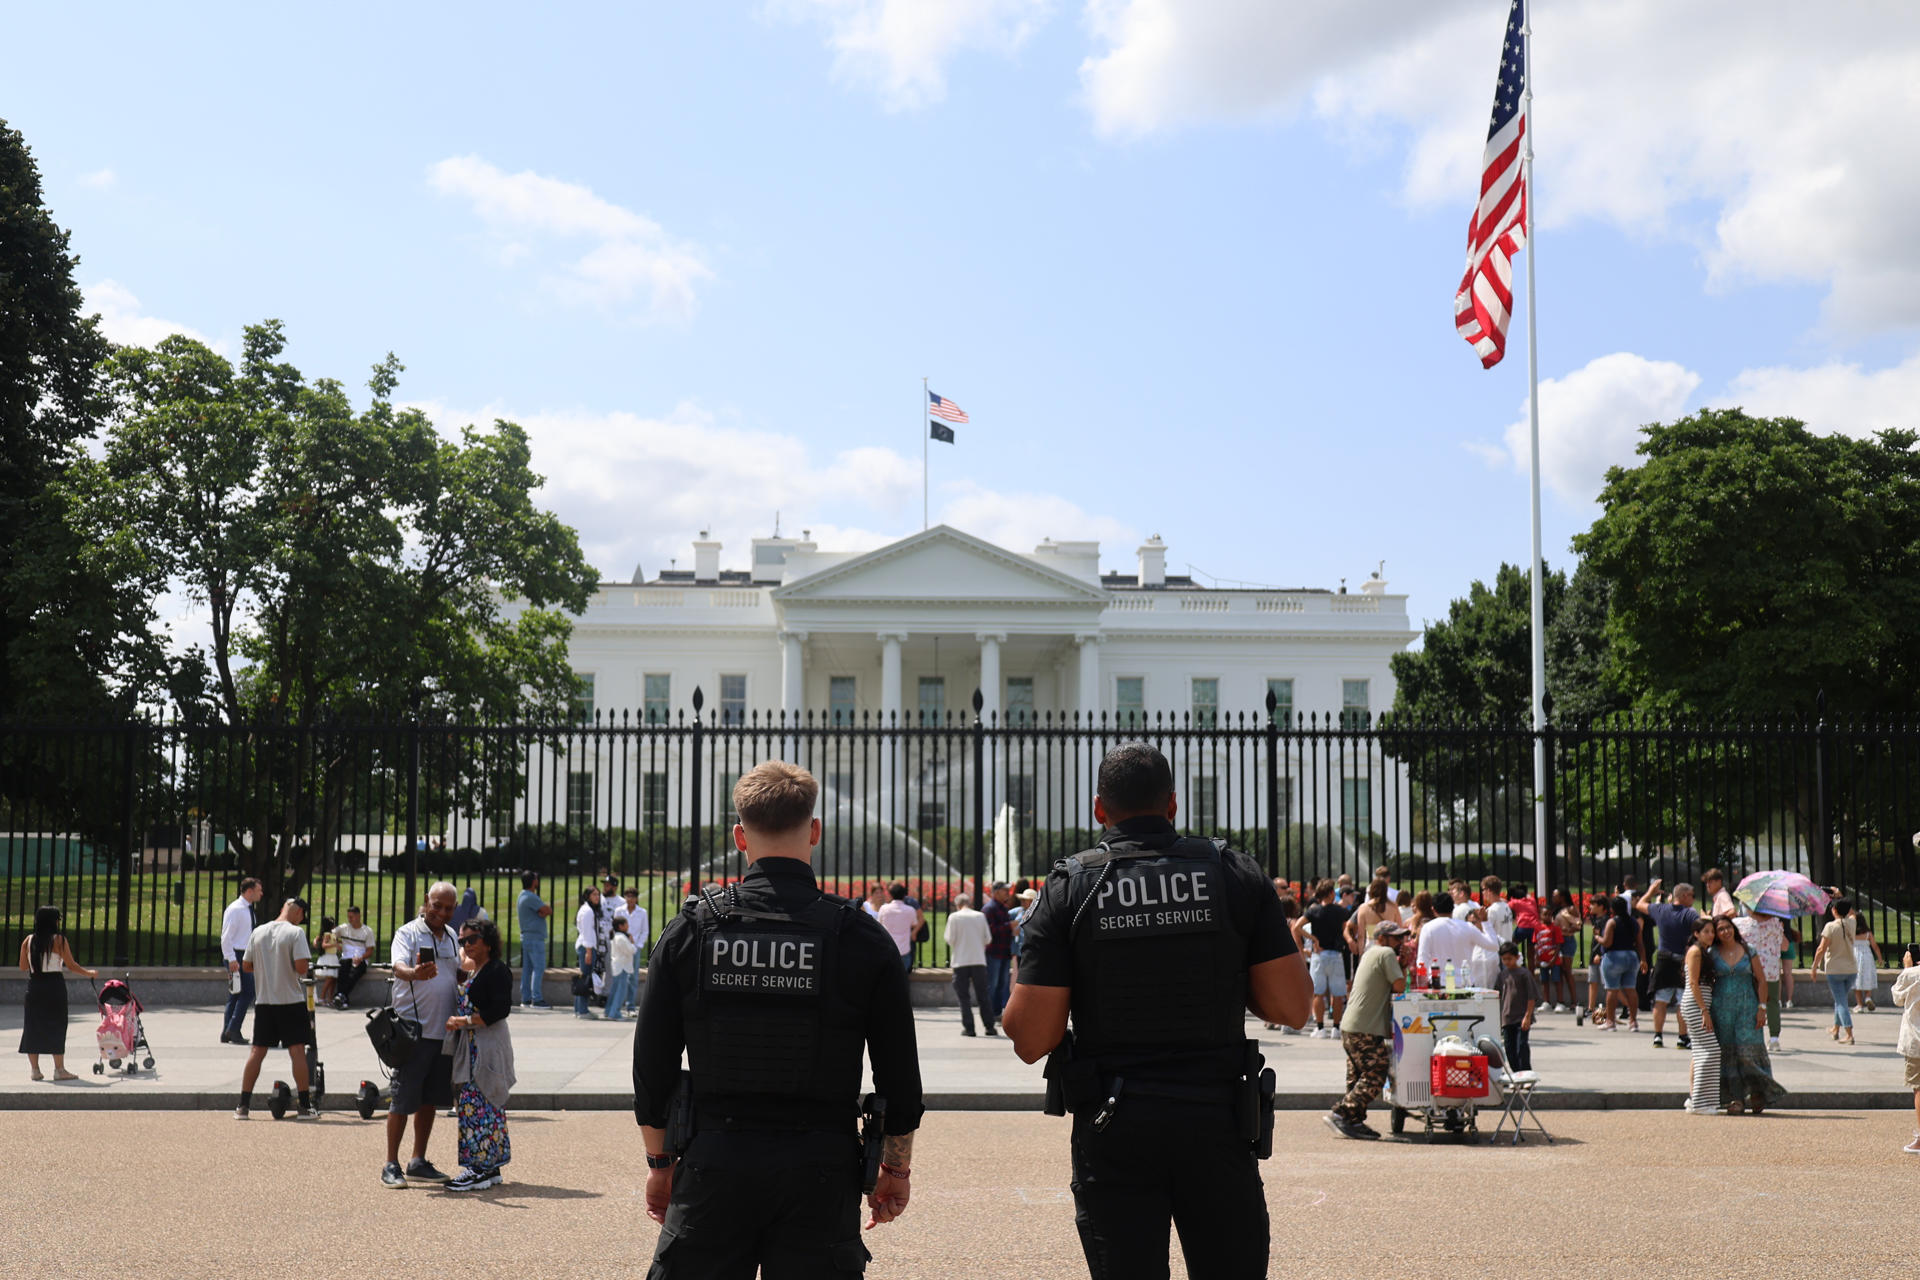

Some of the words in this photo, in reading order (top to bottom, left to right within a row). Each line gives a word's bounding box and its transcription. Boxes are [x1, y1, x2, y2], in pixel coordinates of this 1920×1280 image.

[1097, 871, 1210, 909] POLICE
[1100, 913, 1151, 930] SECRET
[1156, 908, 1212, 925] SERVICE
[712, 939, 815, 970] POLICE
[711, 972, 757, 986] SECRET
[761, 975, 813, 989] SERVICE
